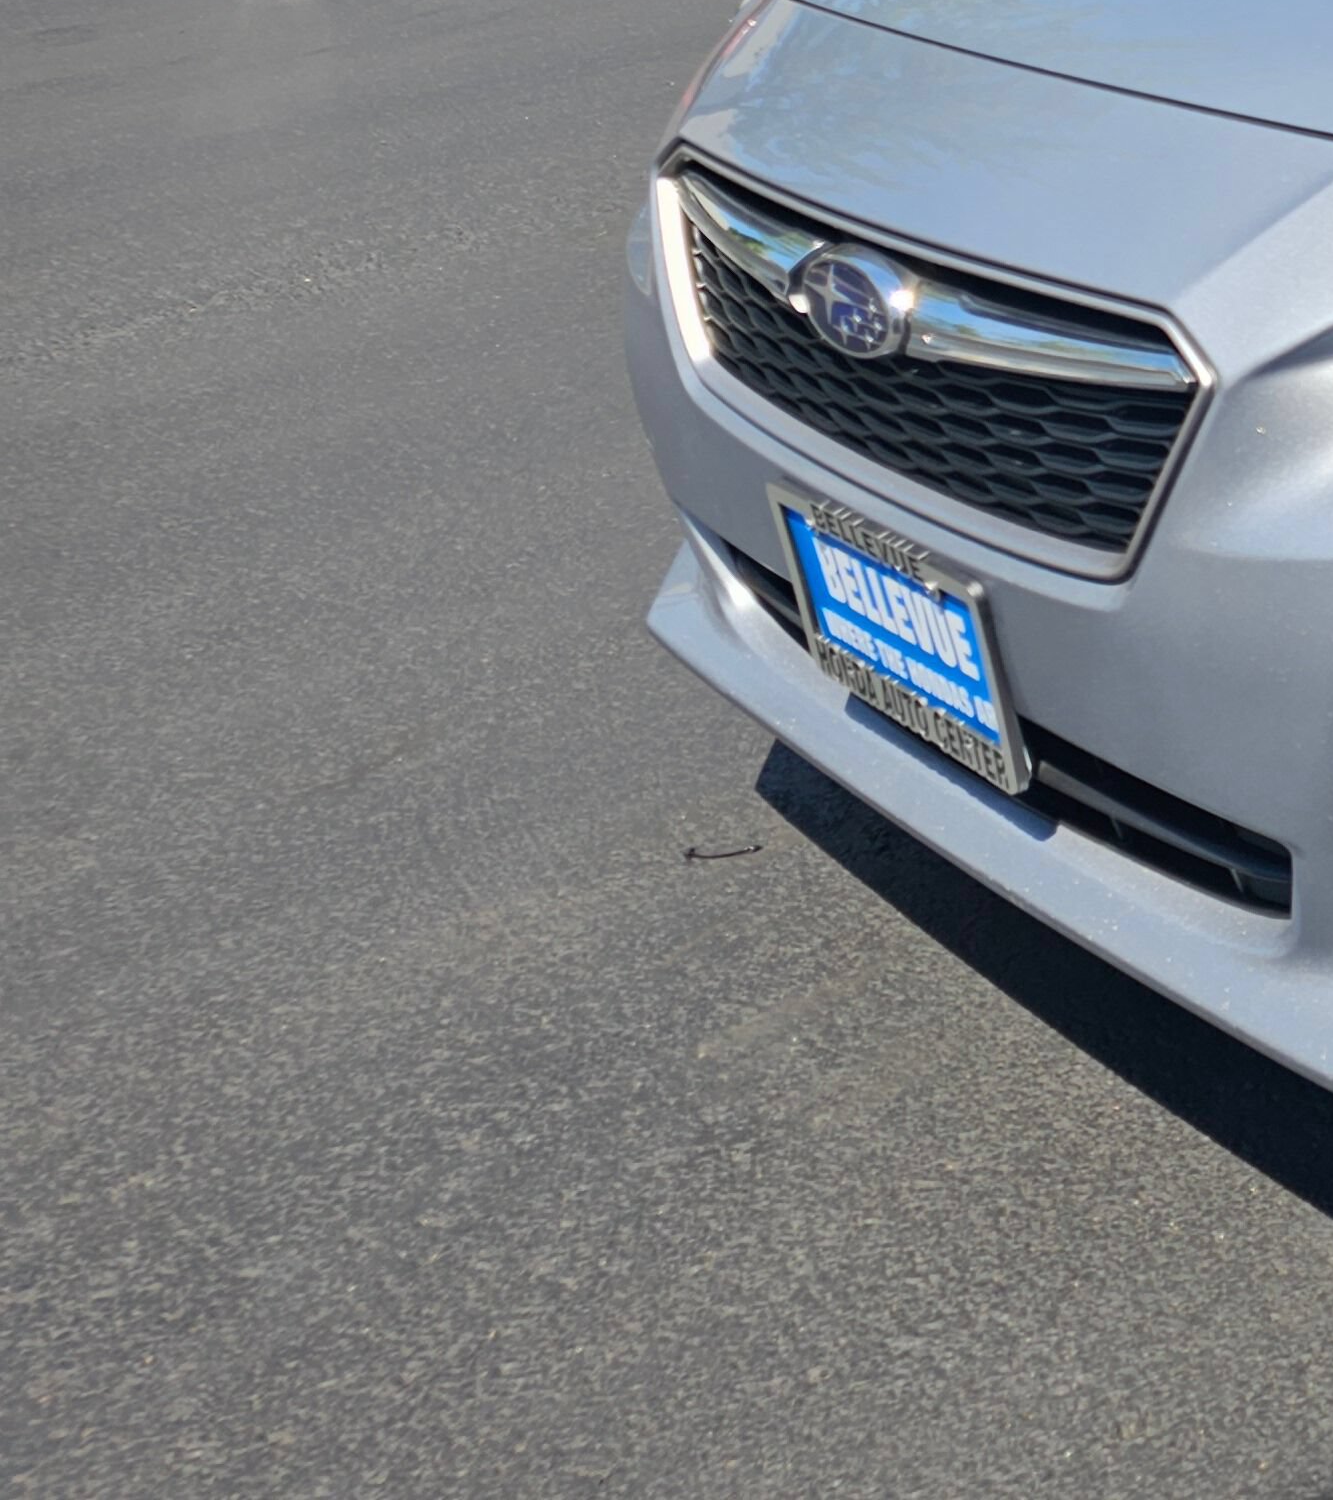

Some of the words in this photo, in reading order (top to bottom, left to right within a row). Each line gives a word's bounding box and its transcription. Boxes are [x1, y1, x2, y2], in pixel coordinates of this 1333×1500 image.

[811, 501, 927, 581] BELLEVUE
[811, 536, 981, 683] BELLEVUE
[814, 636, 878, 703] HONDA
[880, 675, 931, 742] AUTO
[932, 708, 1011, 791] CENTER
[822, 606, 879, 662] WHERE
[873, 638, 909, 680] THE
[973, 694, 999, 734] AR
